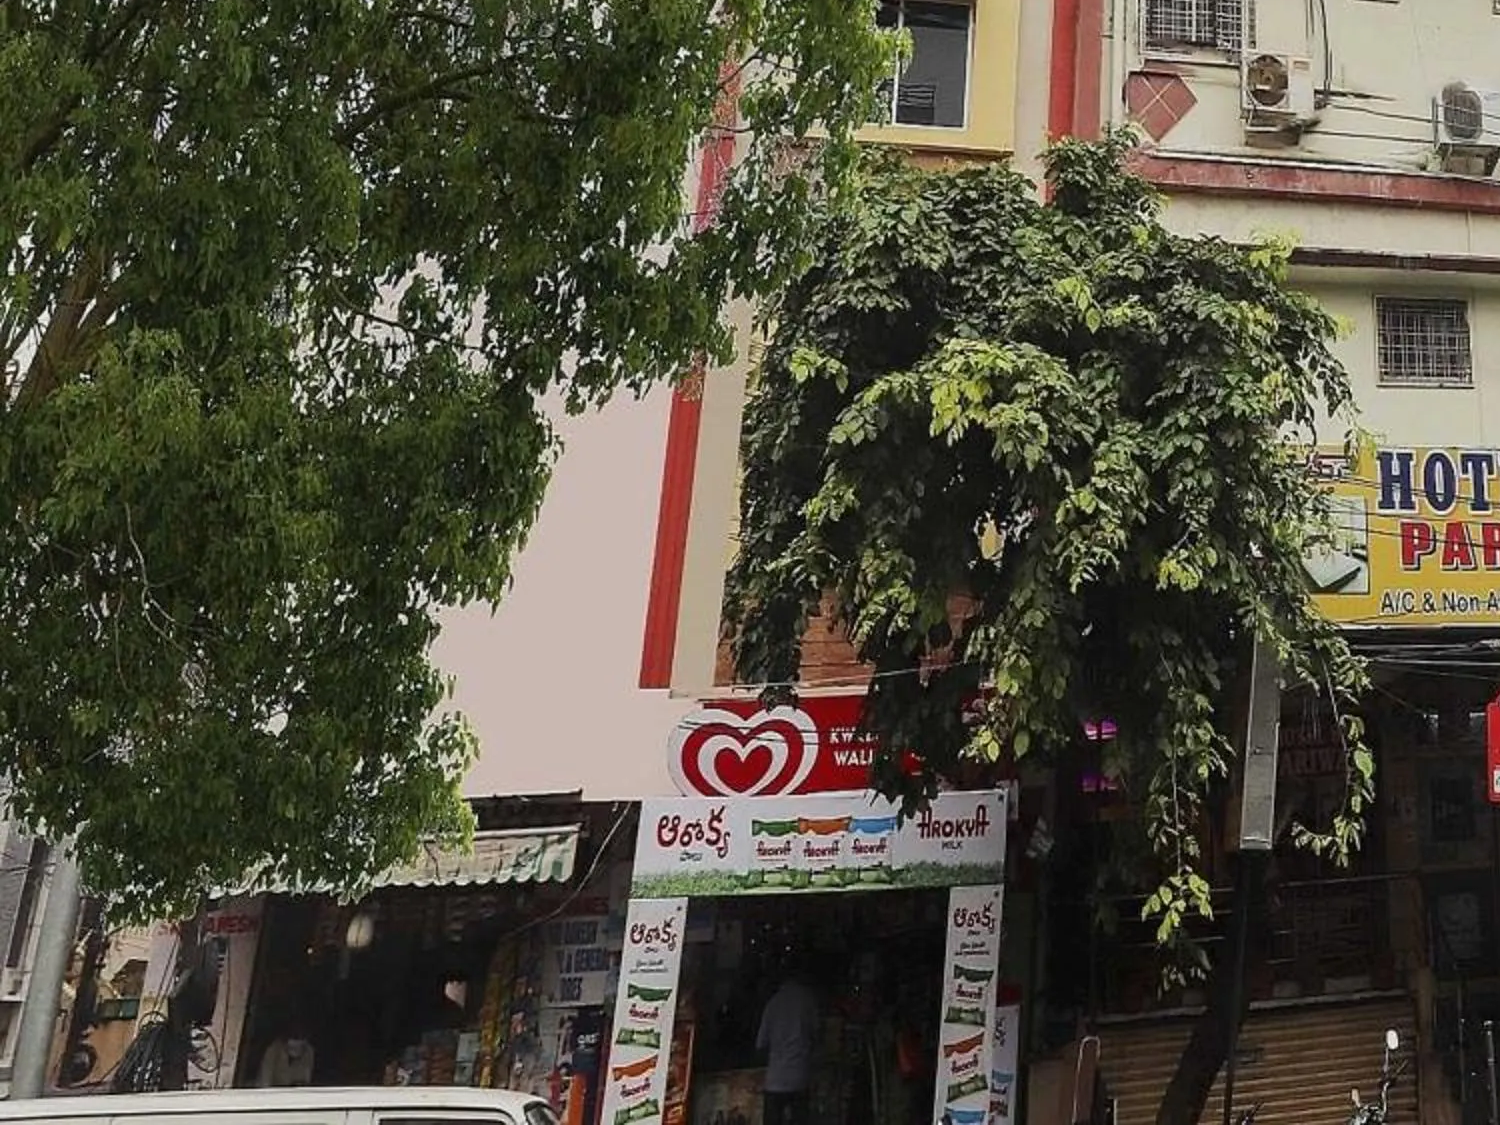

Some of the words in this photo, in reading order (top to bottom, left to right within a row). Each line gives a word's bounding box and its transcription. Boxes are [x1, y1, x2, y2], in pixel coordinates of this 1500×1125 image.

[1382, 590, 1416, 613] A/C
[1422, 592, 1436, 613] &
[917, 804, 991, 840] AROKYA
